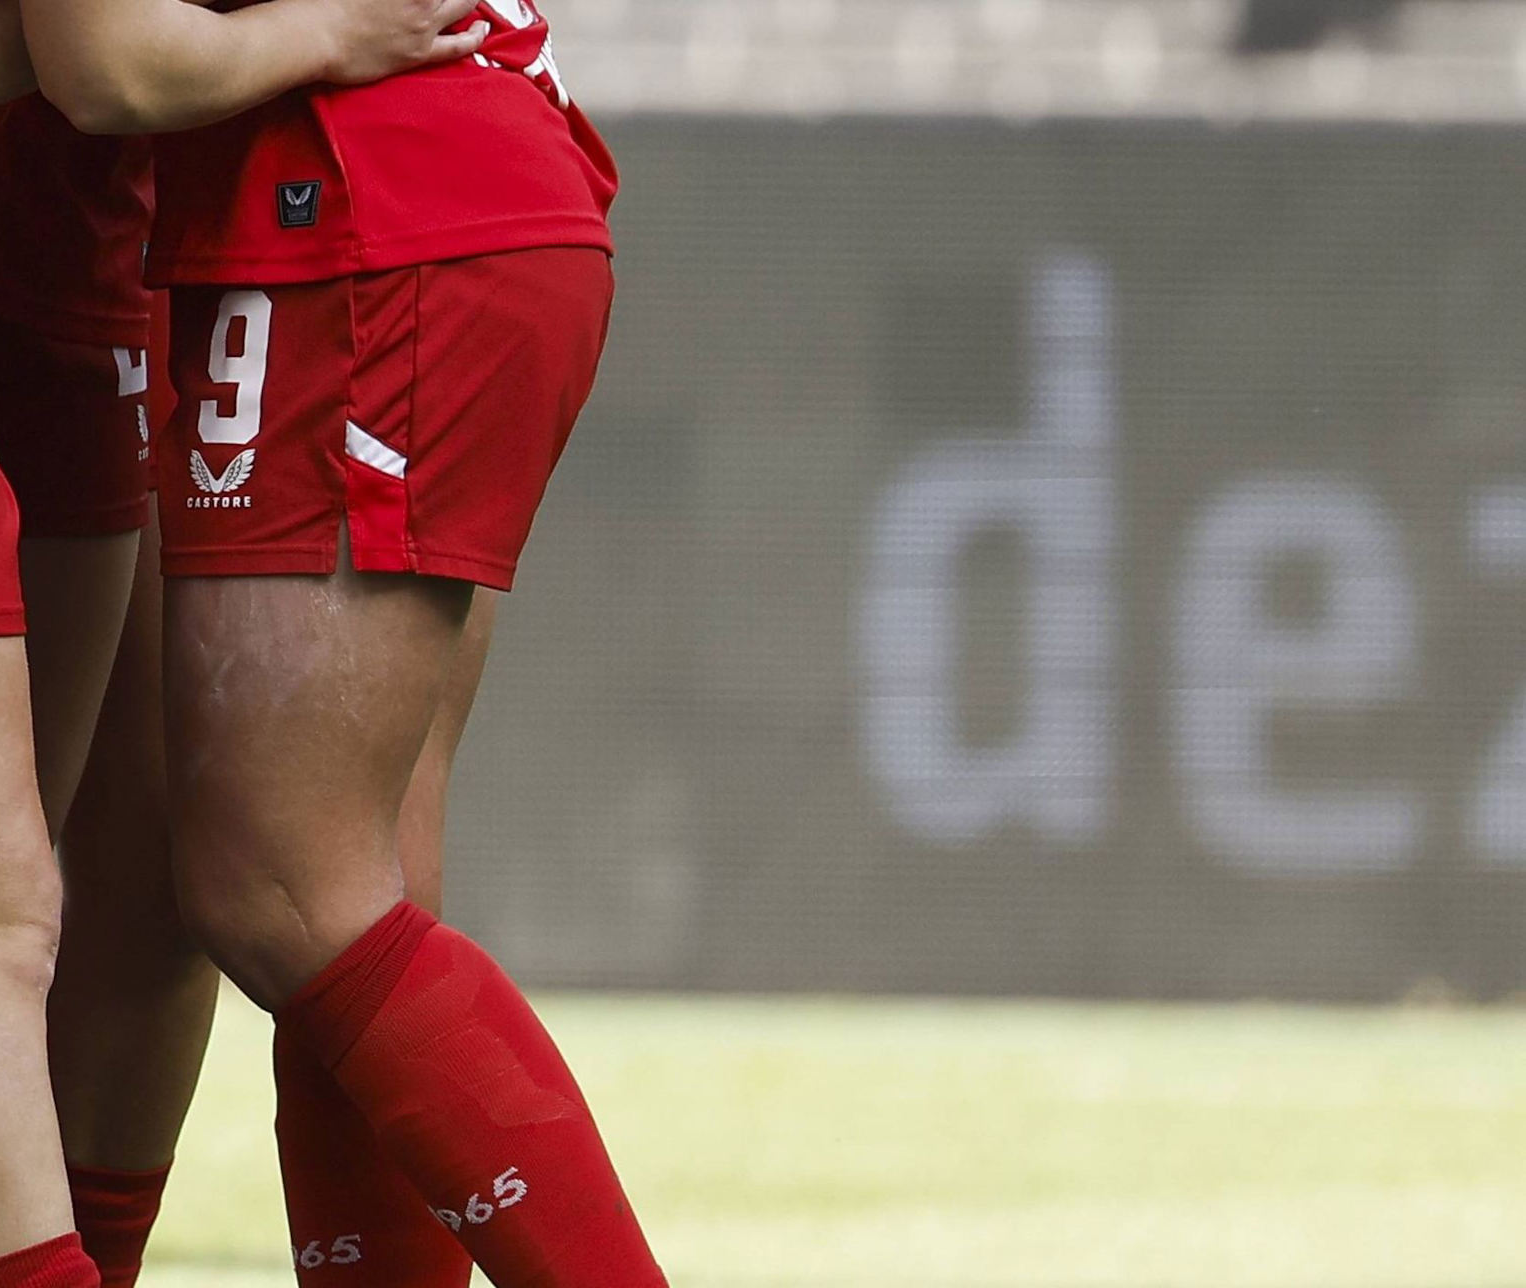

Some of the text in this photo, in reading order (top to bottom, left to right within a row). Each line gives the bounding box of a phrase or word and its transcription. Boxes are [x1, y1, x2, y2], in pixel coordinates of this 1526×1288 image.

[198, 289, 273, 445] 9
[186, 496, 252, 509] CASTORE
[427, 1166, 528, 1233] 965
[290, 1233, 362, 1270] 65
